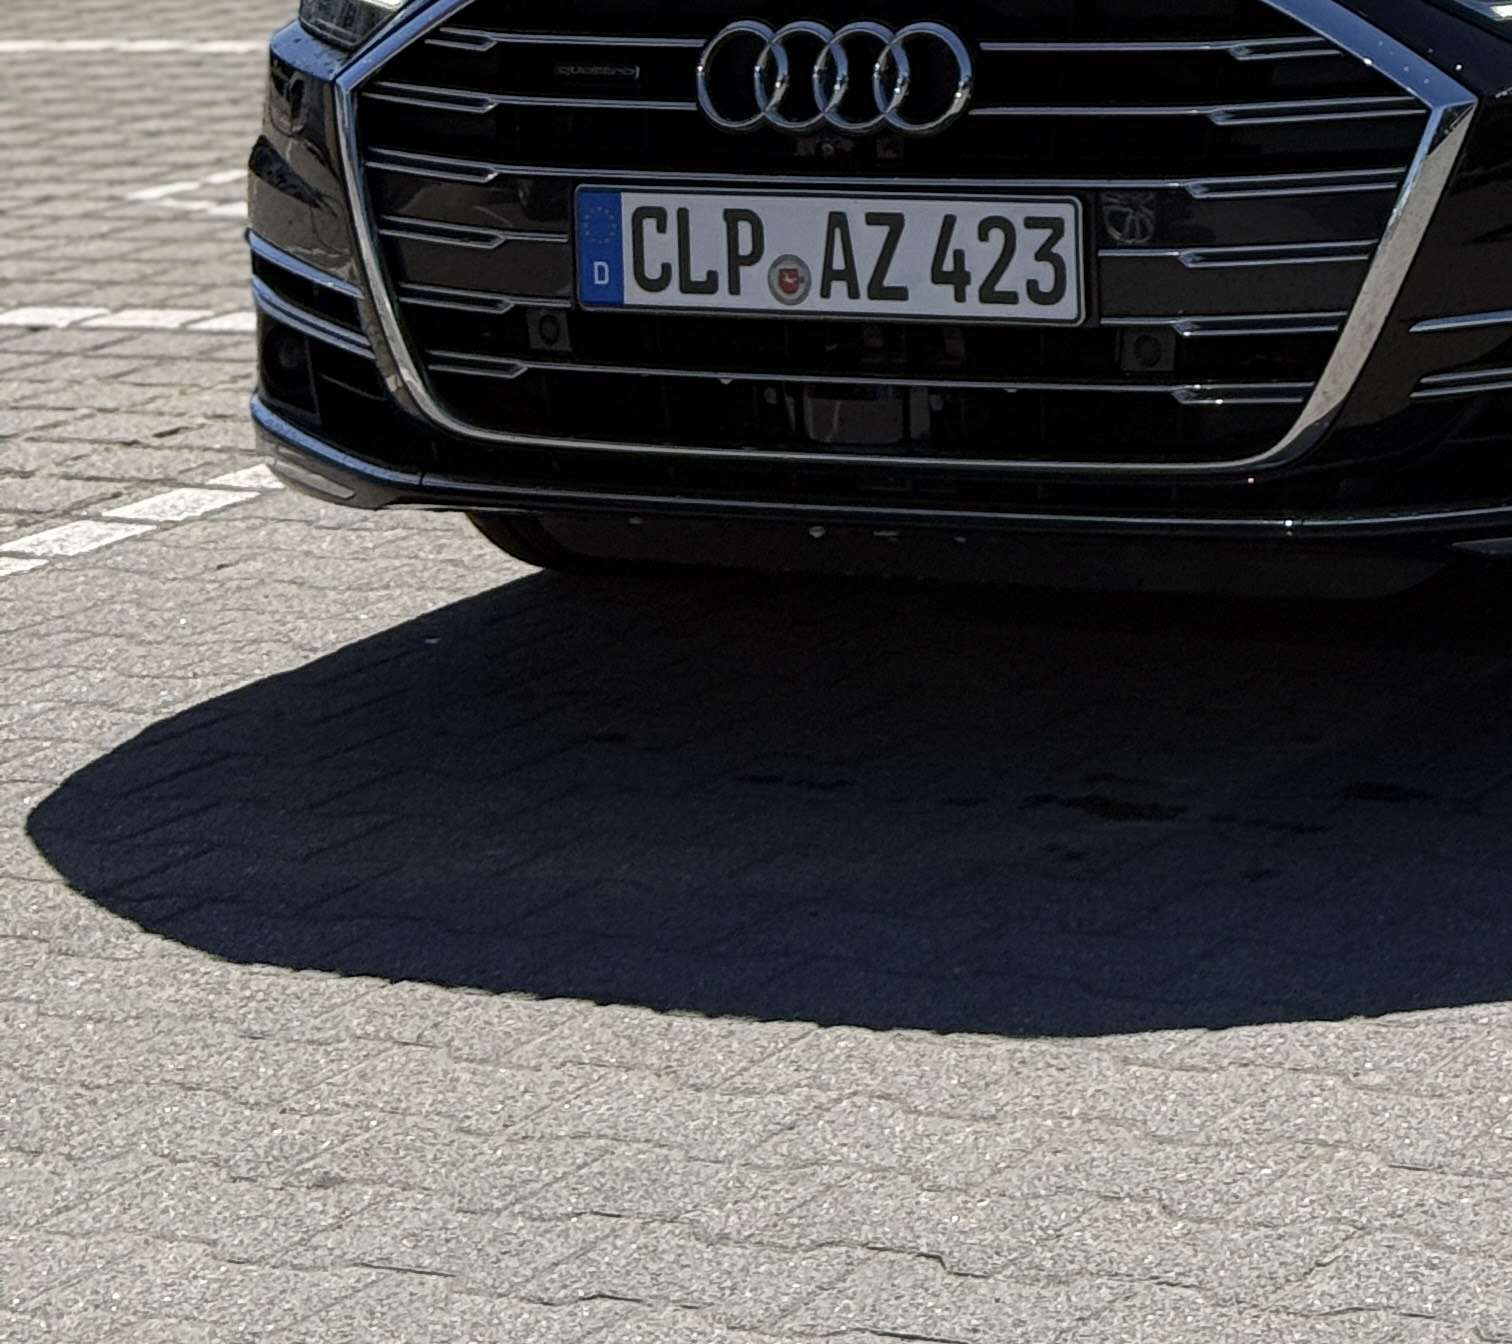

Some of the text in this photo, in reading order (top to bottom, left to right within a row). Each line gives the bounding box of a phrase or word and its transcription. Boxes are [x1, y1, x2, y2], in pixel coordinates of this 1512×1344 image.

[593, 261, 610, 285] D
[631, 206, 765, 296] CLP
[819, 211, 910, 301] AZ
[930, 214, 1067, 306] 423
